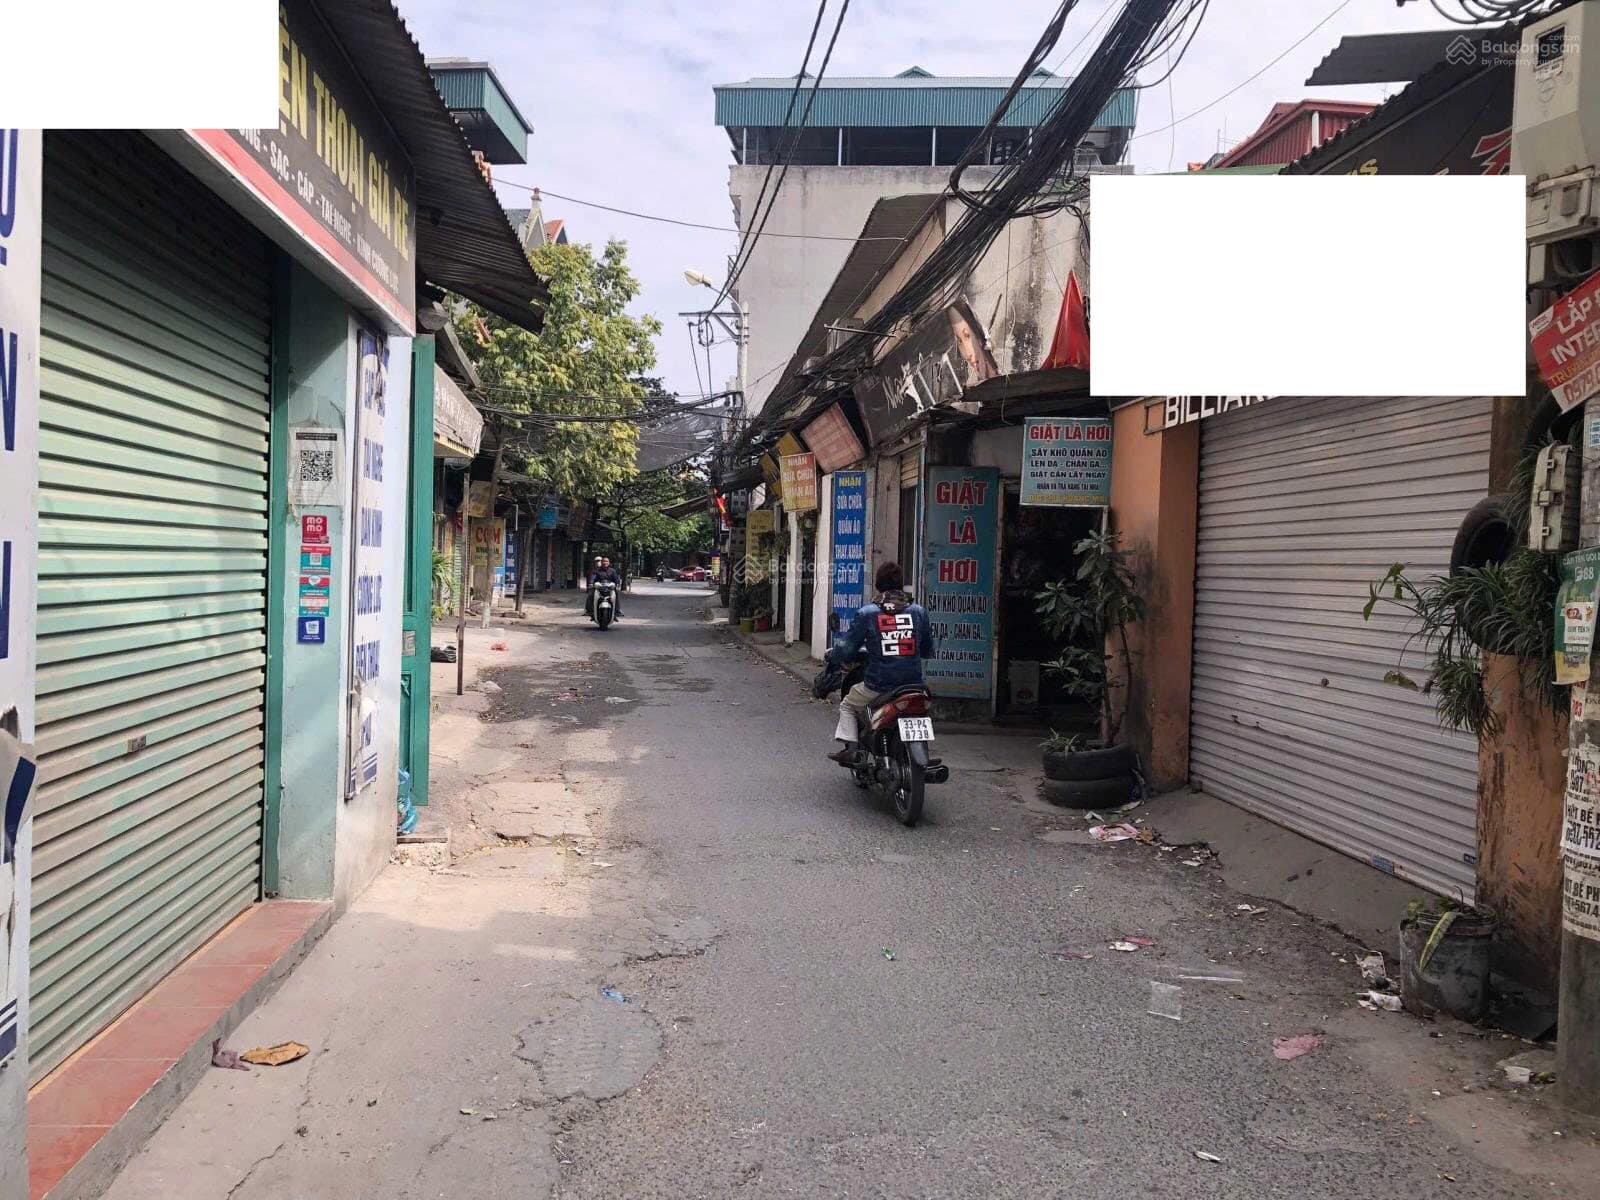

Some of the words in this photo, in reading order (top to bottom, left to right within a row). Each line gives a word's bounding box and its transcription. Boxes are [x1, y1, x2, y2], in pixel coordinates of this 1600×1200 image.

[313, 70, 364, 214] THOẠI
[368, 150, 391, 241] GIÁ
[270, 141, 290, 182] SẠC
[297, 172, 315, 205] CÁP
[1557, 296, 1593, 335] LẮP
[1030, 424, 1061, 443] GIẶT
[1064, 423, 1083, 441] LÀ
[1086, 425, 1111, 441] HƠI
[1030, 460, 1046, 468] LEN
[935, 477, 988, 510] GIẶT
[948, 515, 978, 545] LÀ
[938, 558, 979, 583] HƠI
